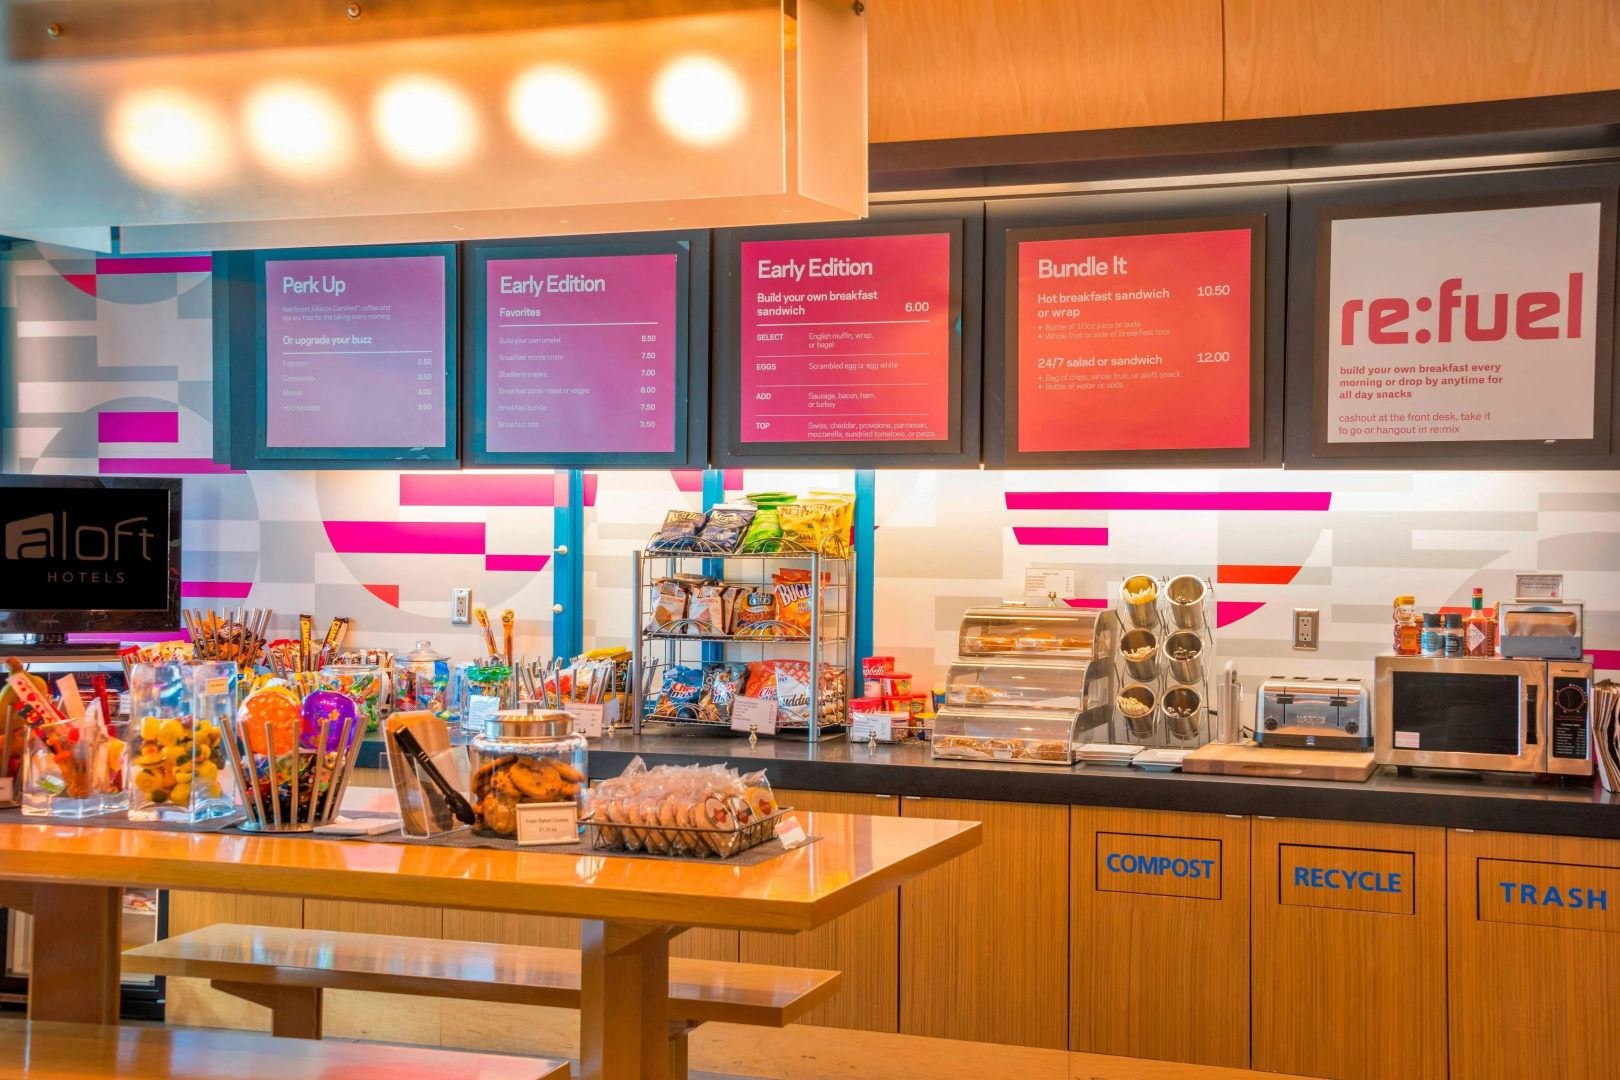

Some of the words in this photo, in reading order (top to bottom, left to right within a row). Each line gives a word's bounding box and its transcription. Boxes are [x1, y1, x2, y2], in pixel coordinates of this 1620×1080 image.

[758, 259, 805, 282] Early
[809, 258, 872, 277] Edition
[1038, 256, 1108, 278] Bundle
[1113, 255, 1127, 274] It
[283, 276, 319, 294] Perk
[323, 276, 345, 296] Up
[500, 275, 544, 297] Early
[547, 275, 606, 292] Edition
[1197, 285, 1230, 297] 10.50
[758, 292, 781, 302] Build
[784, 294, 805, 304] your
[830, 290, 878, 300] breakfast
[1038, 294, 1058, 304] Hot
[1059, 291, 1112, 303] breakfast
[1115, 288, 1170, 300] sandwich
[500, 308, 540, 317] Favorites
[757, 306, 805, 316] sandwich
[905, 302, 929, 312] 6.00
[1341, 272, 1583, 345] re:fuel
[1038, 309, 1049, 318] or
[1052, 309, 1080, 319] wrap
[283, 336, 293, 344] Or
[295, 335, 330, 346] upgrade
[332, 336, 350, 346] your
[352, 335, 372, 344] buzz
[1038, 357, 1064, 368] 24/7
[1067, 356, 1094, 367] salad
[1111, 354, 1162, 365] sandwich
[1197, 352, 1229, 363] 12.00
[1340, 366, 1365, 374] build
[1368, 367, 1391, 376] your
[1419, 364, 1468, 373] breakfast
[1472, 364, 1501, 373] every
[1340, 379, 1382, 388] morning
[1399, 378, 1422, 386] drop
[1426, 377, 1438, 386] by
[1442, 376, 1484, 386] anytime
[1488, 375, 1502, 384] for
[1340, 390, 1351, 399] all
[1355, 390, 1373, 400] day
[1339, 414, 1376, 422] cashout
[1408, 413, 1430, 421] front
[1433, 413, 1458, 421] desk,
[1461, 412, 1481, 420] take
[1484, 412, 1490, 420] it
[1351, 427, 1362, 436] go
[1376, 426, 1415, 435] hangout
[1430, 425, 1460, 433] re:mix
[5, 511, 155, 561] aloft
[48, 572, 125, 583] HOTELS
[672, 682, 699, 692] Chex
[1106, 853, 1214, 880] COMPOST
[1294, 866, 1402, 893] RECYCLE
[1500, 882, 1608, 910] TRASH
